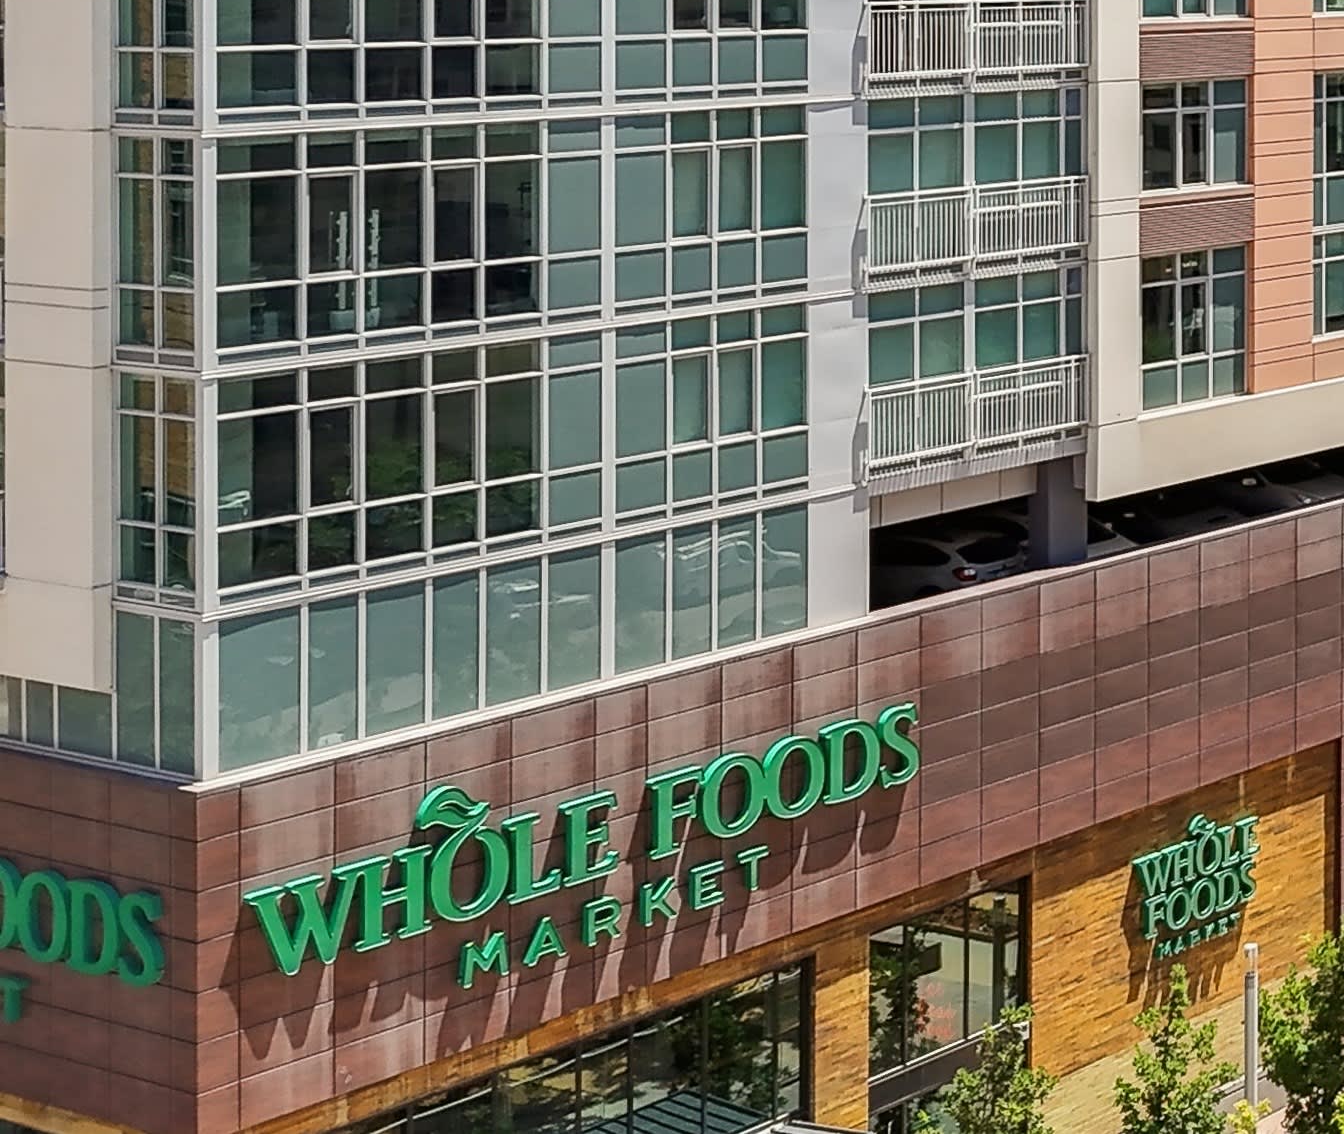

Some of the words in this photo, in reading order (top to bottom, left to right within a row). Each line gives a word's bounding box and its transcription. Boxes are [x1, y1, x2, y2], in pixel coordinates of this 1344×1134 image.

[243, 784, 618, 976] WHOLE
[645, 702, 921, 861] FOODS
[1132, 813, 1261, 896] WHOLE
[457, 844, 771, 990] MARKET
[1143, 861, 1257, 940] FOODS
